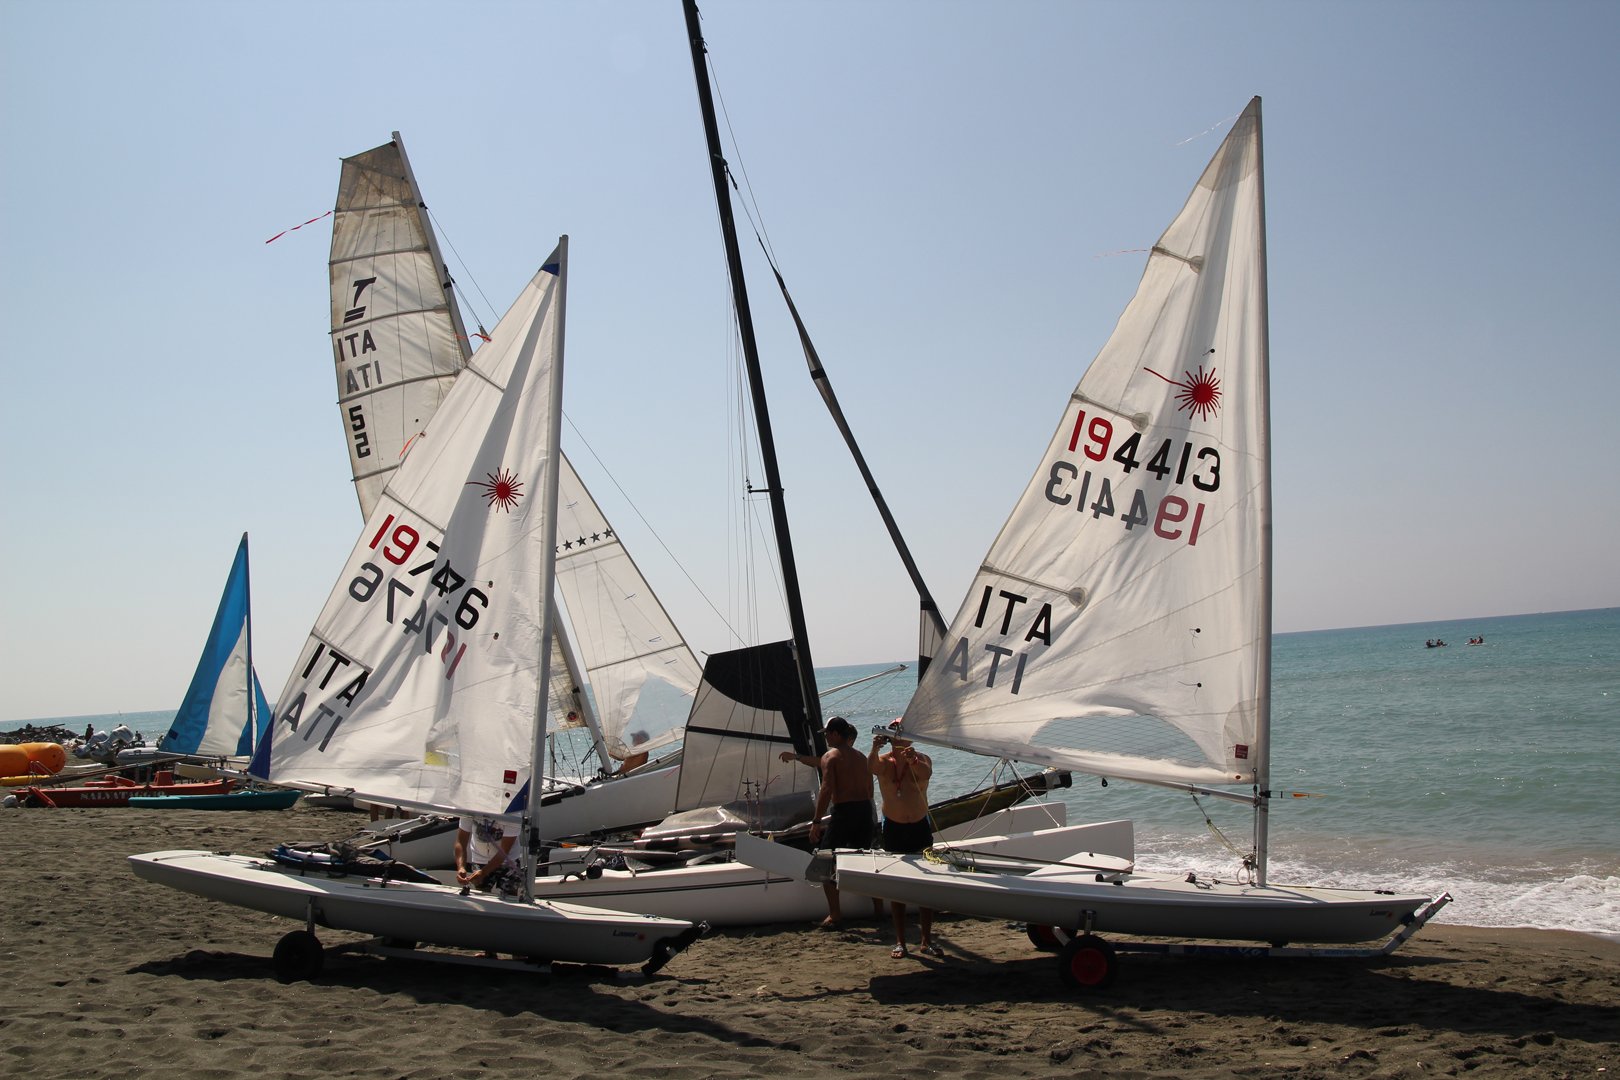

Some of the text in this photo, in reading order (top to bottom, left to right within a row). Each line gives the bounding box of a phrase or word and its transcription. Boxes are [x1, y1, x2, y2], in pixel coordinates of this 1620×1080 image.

[337, 329, 377, 362] ITA
[1067, 409, 1221, 492] 194413
[974, 585, 1052, 647] ITA
[301, 642, 372, 707] ITA
